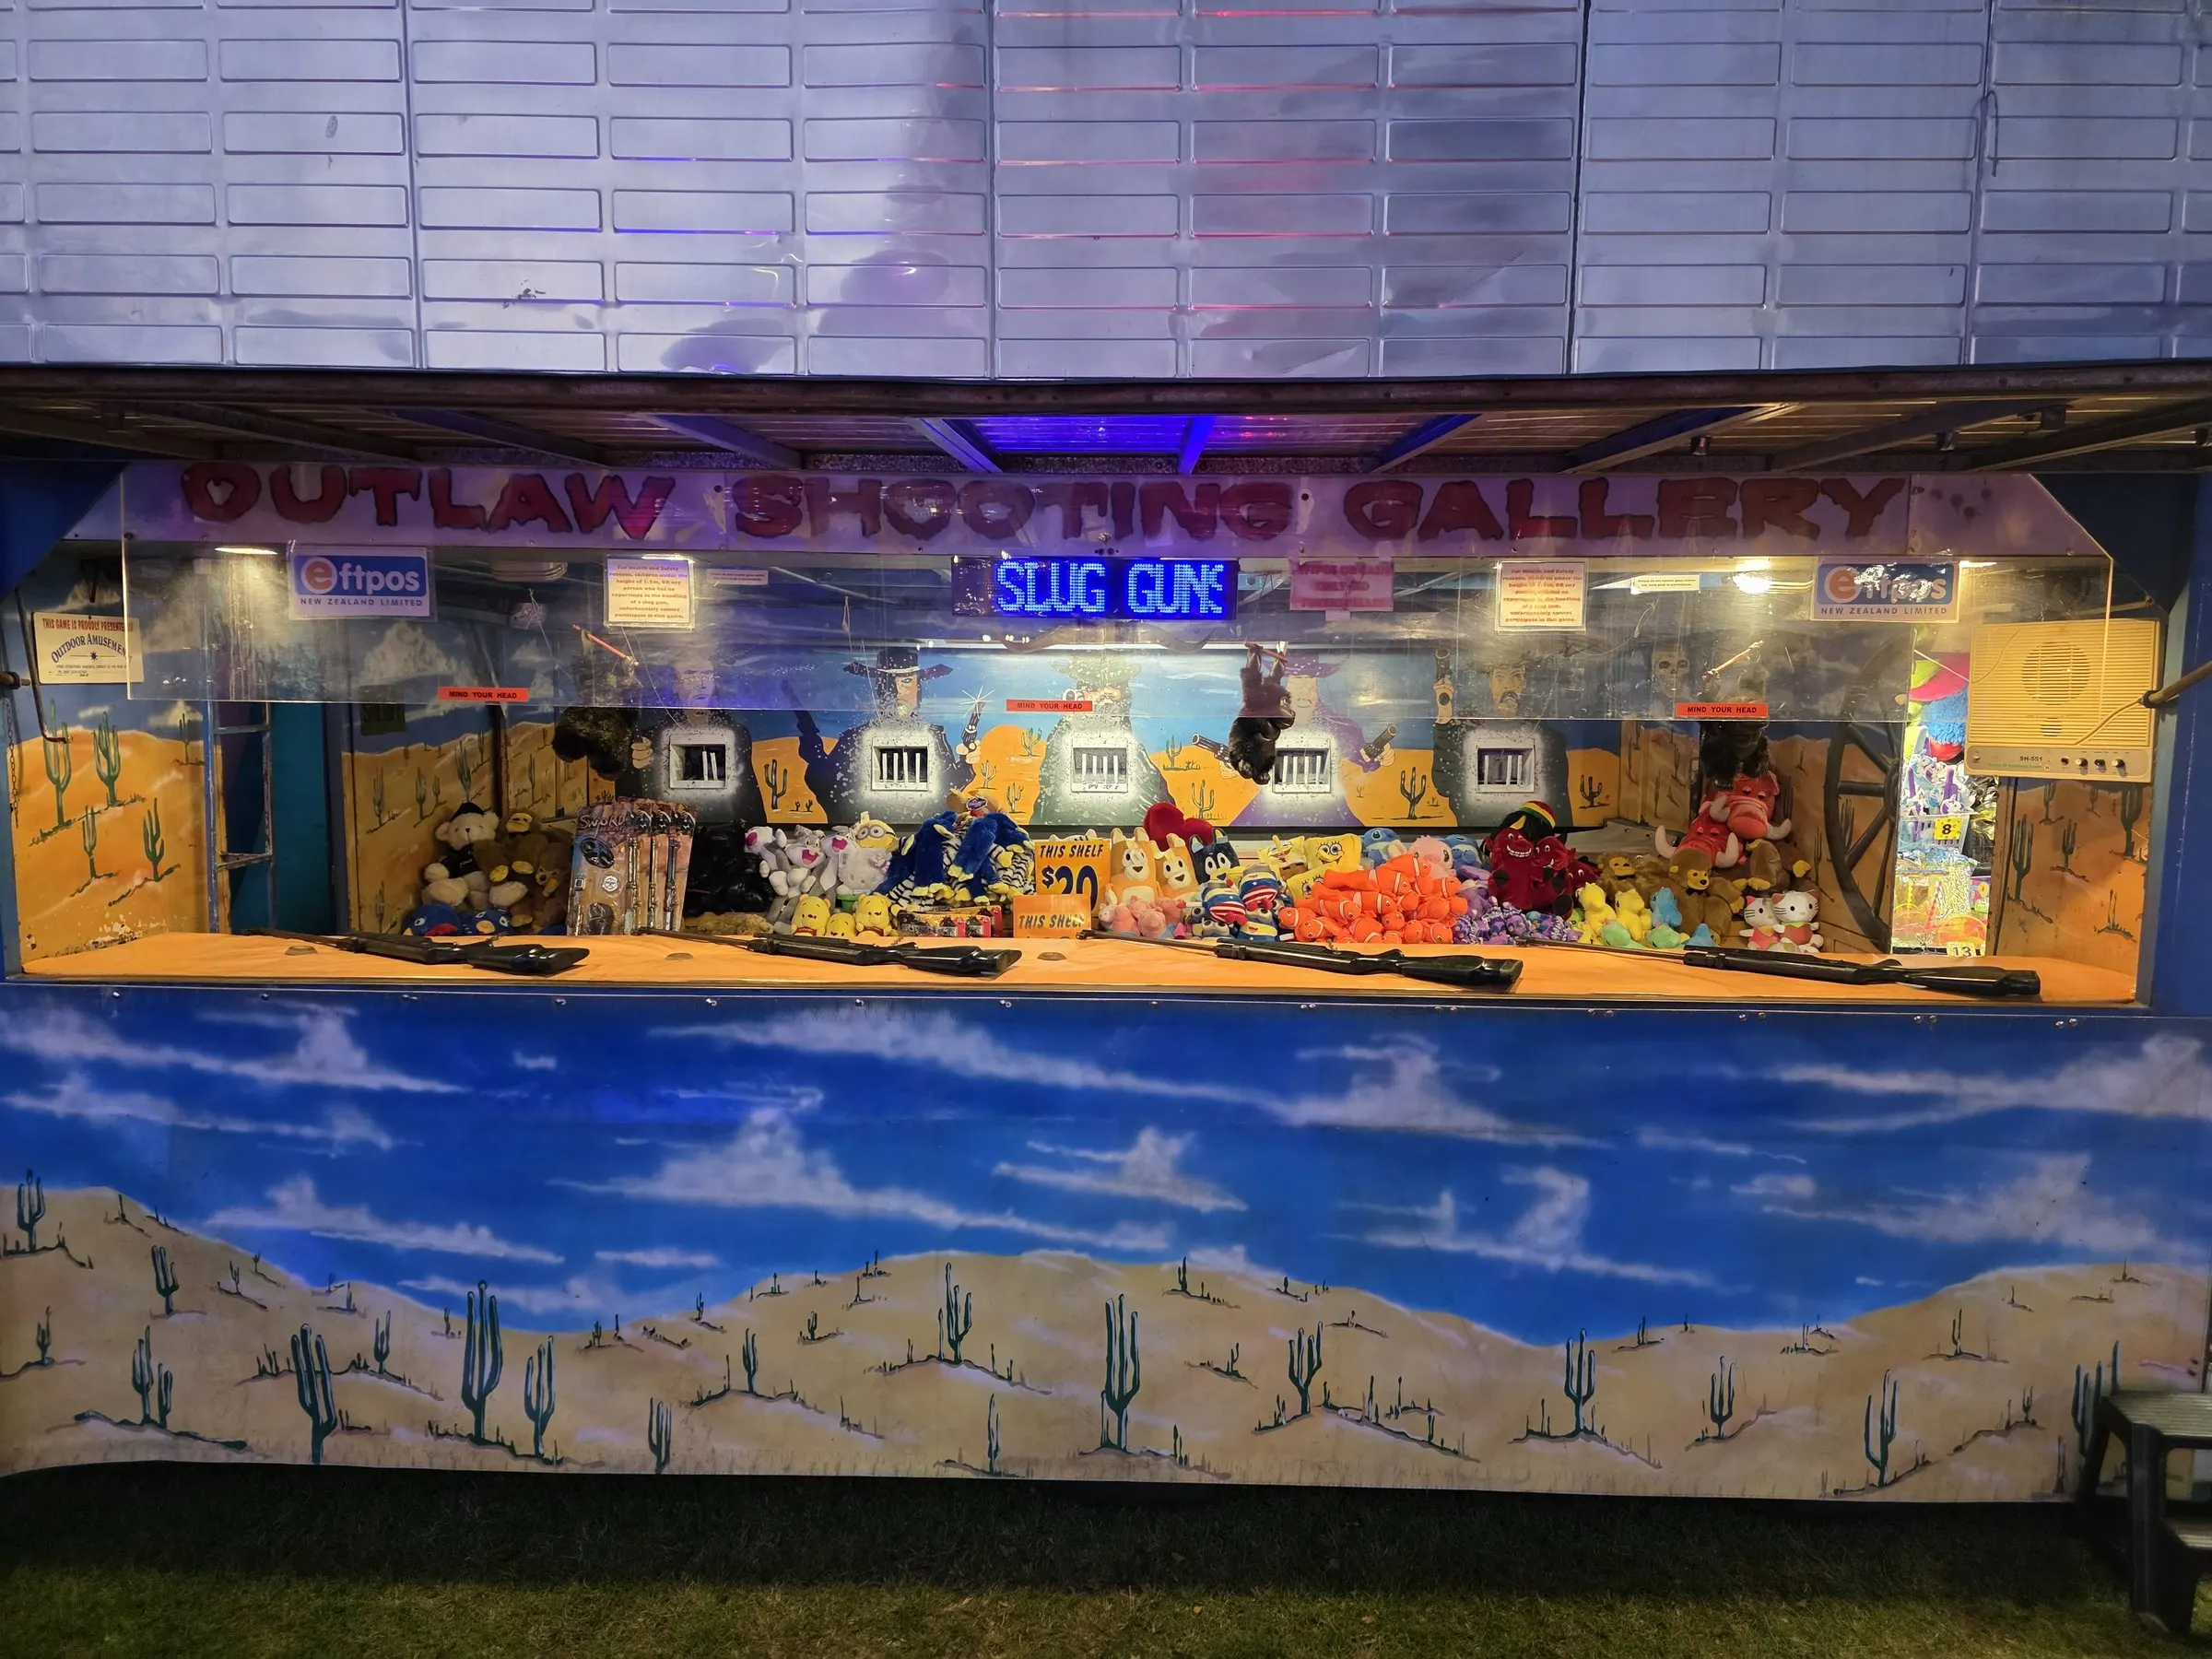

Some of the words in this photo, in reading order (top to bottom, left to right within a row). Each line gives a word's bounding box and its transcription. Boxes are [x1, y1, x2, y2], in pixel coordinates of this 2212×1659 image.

[182, 464, 676, 540] OUTLAW
[732, 475, 1293, 540] SHOOTING
[1343, 477, 1905, 540] GALLERY
[300, 557, 421, 595] eftpos
[996, 561, 1106, 612] SLUG
[56, 619, 70, 629] GAME
[51, 635, 86, 664] OUTDOOR
[1942, 824, 1951, 835] 8
[1040, 844, 1065, 858] THIS
[1069, 844, 1104, 858] SHELF
[1019, 914, 1045, 929] THIS
